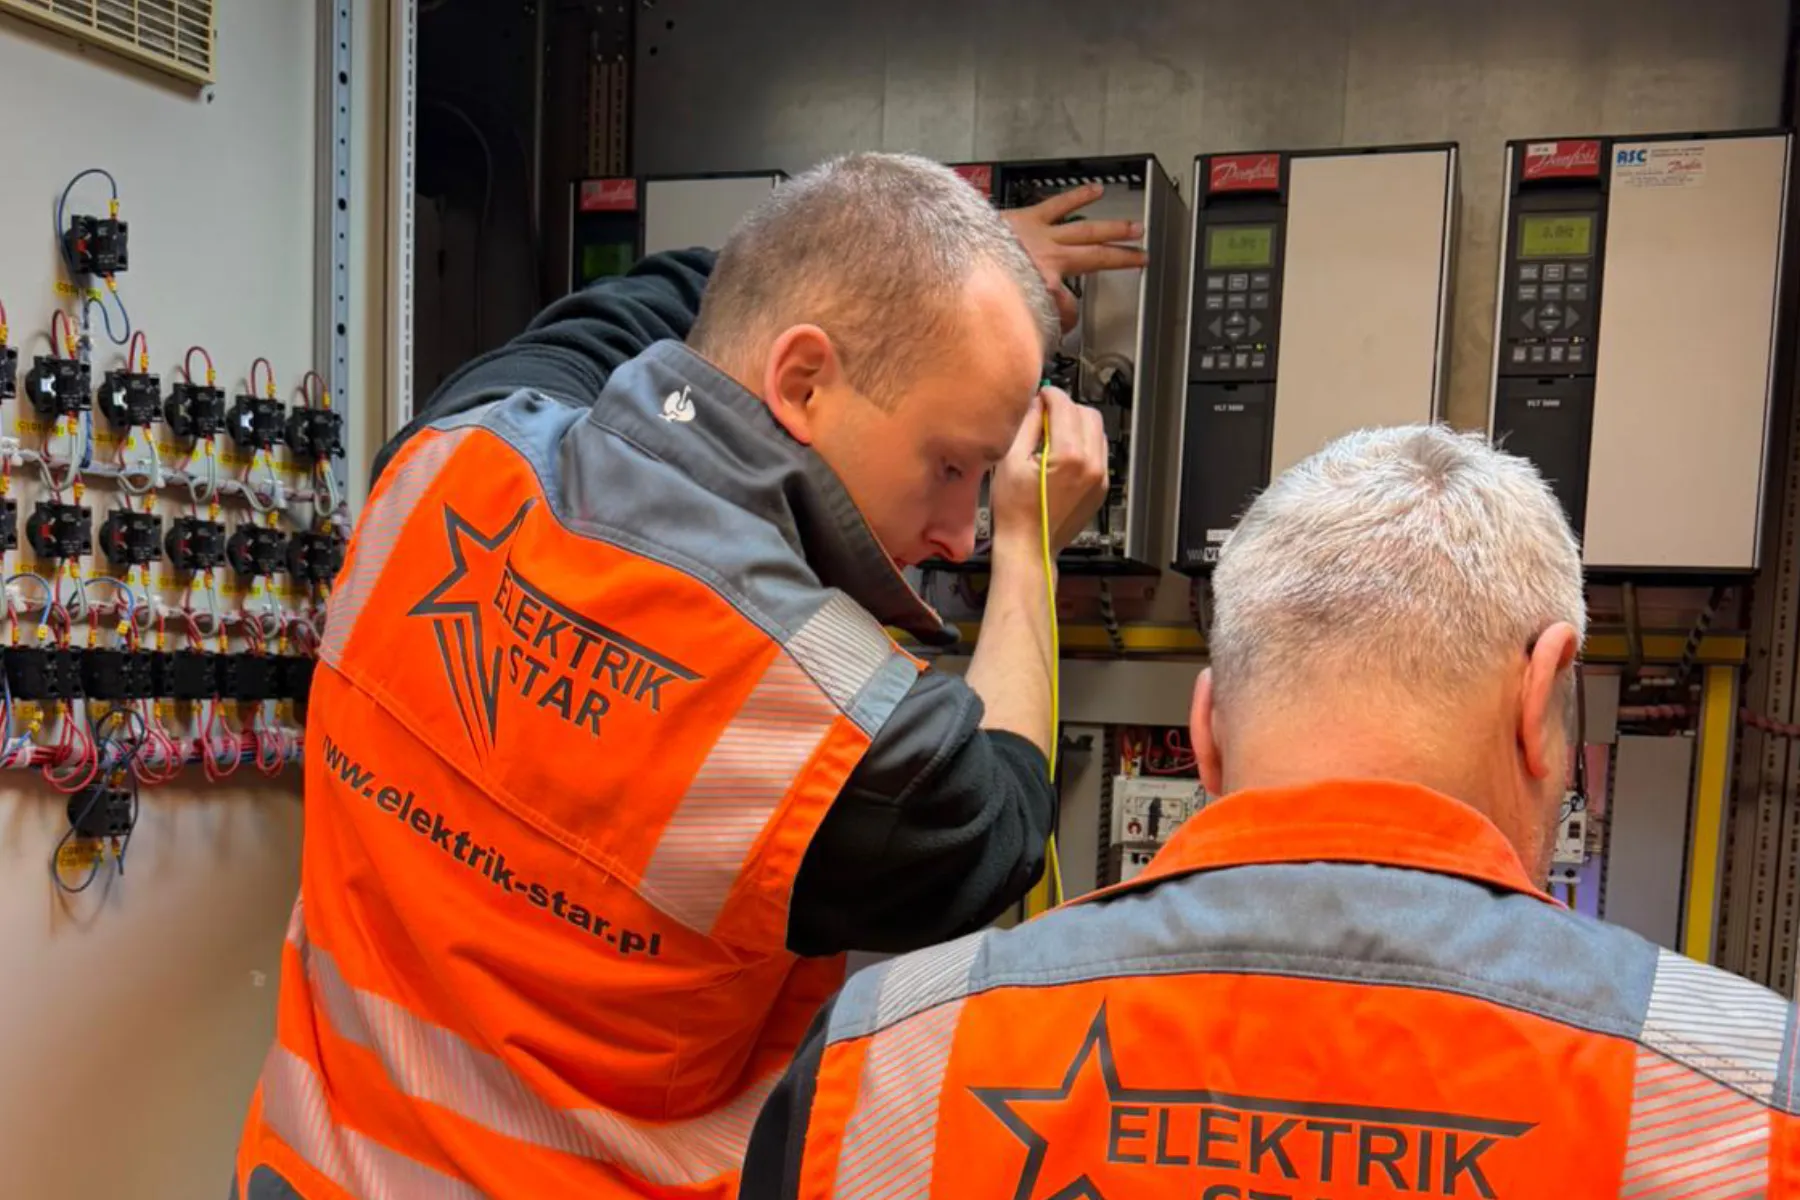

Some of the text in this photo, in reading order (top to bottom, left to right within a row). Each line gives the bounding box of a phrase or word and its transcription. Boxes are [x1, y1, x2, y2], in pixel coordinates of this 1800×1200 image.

[493, 569, 679, 712] ELEKTRIK
[509, 643, 611, 736] STAR
[1107, 1105, 1499, 1200] ELEKTRIK
